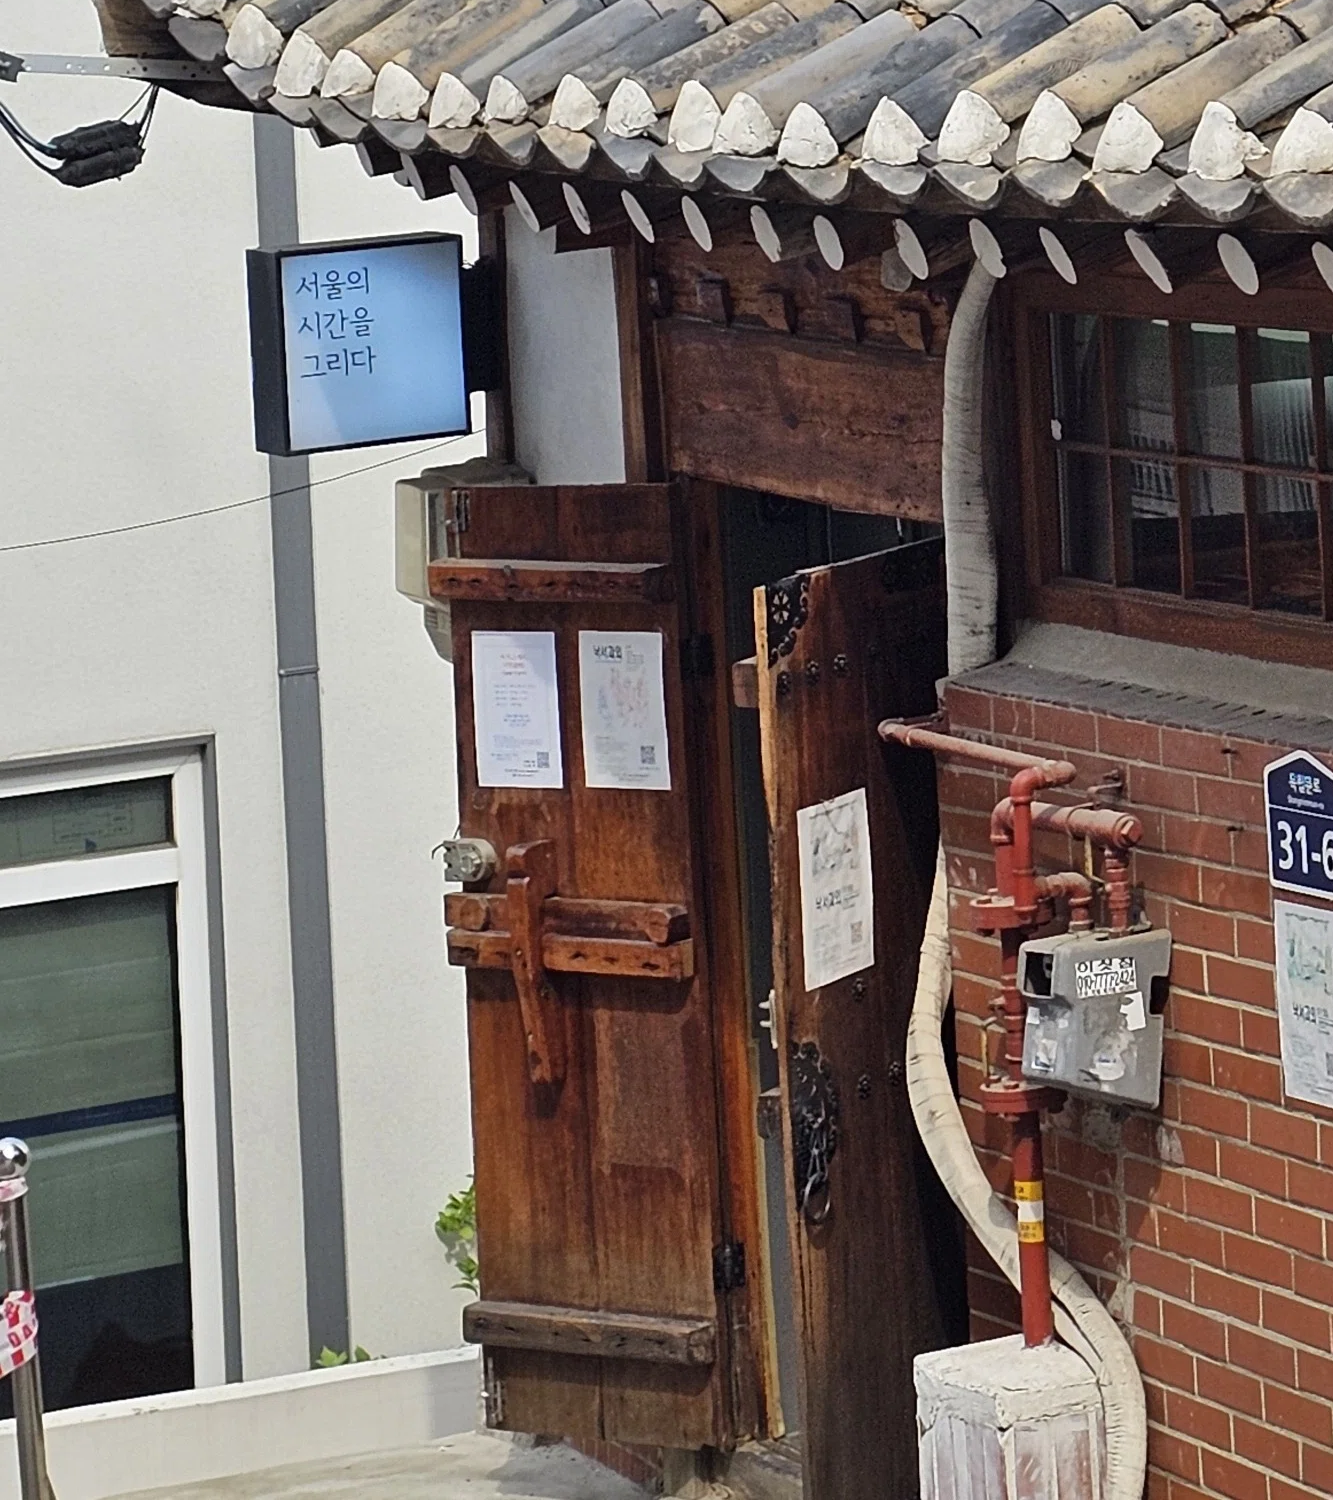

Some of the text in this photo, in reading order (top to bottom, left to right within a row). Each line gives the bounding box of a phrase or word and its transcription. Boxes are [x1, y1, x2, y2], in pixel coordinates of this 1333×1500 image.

[296, 266, 370, 301] 서울의
[297, 306, 374, 340] 시간을
[300, 346, 376, 379] 그리다
